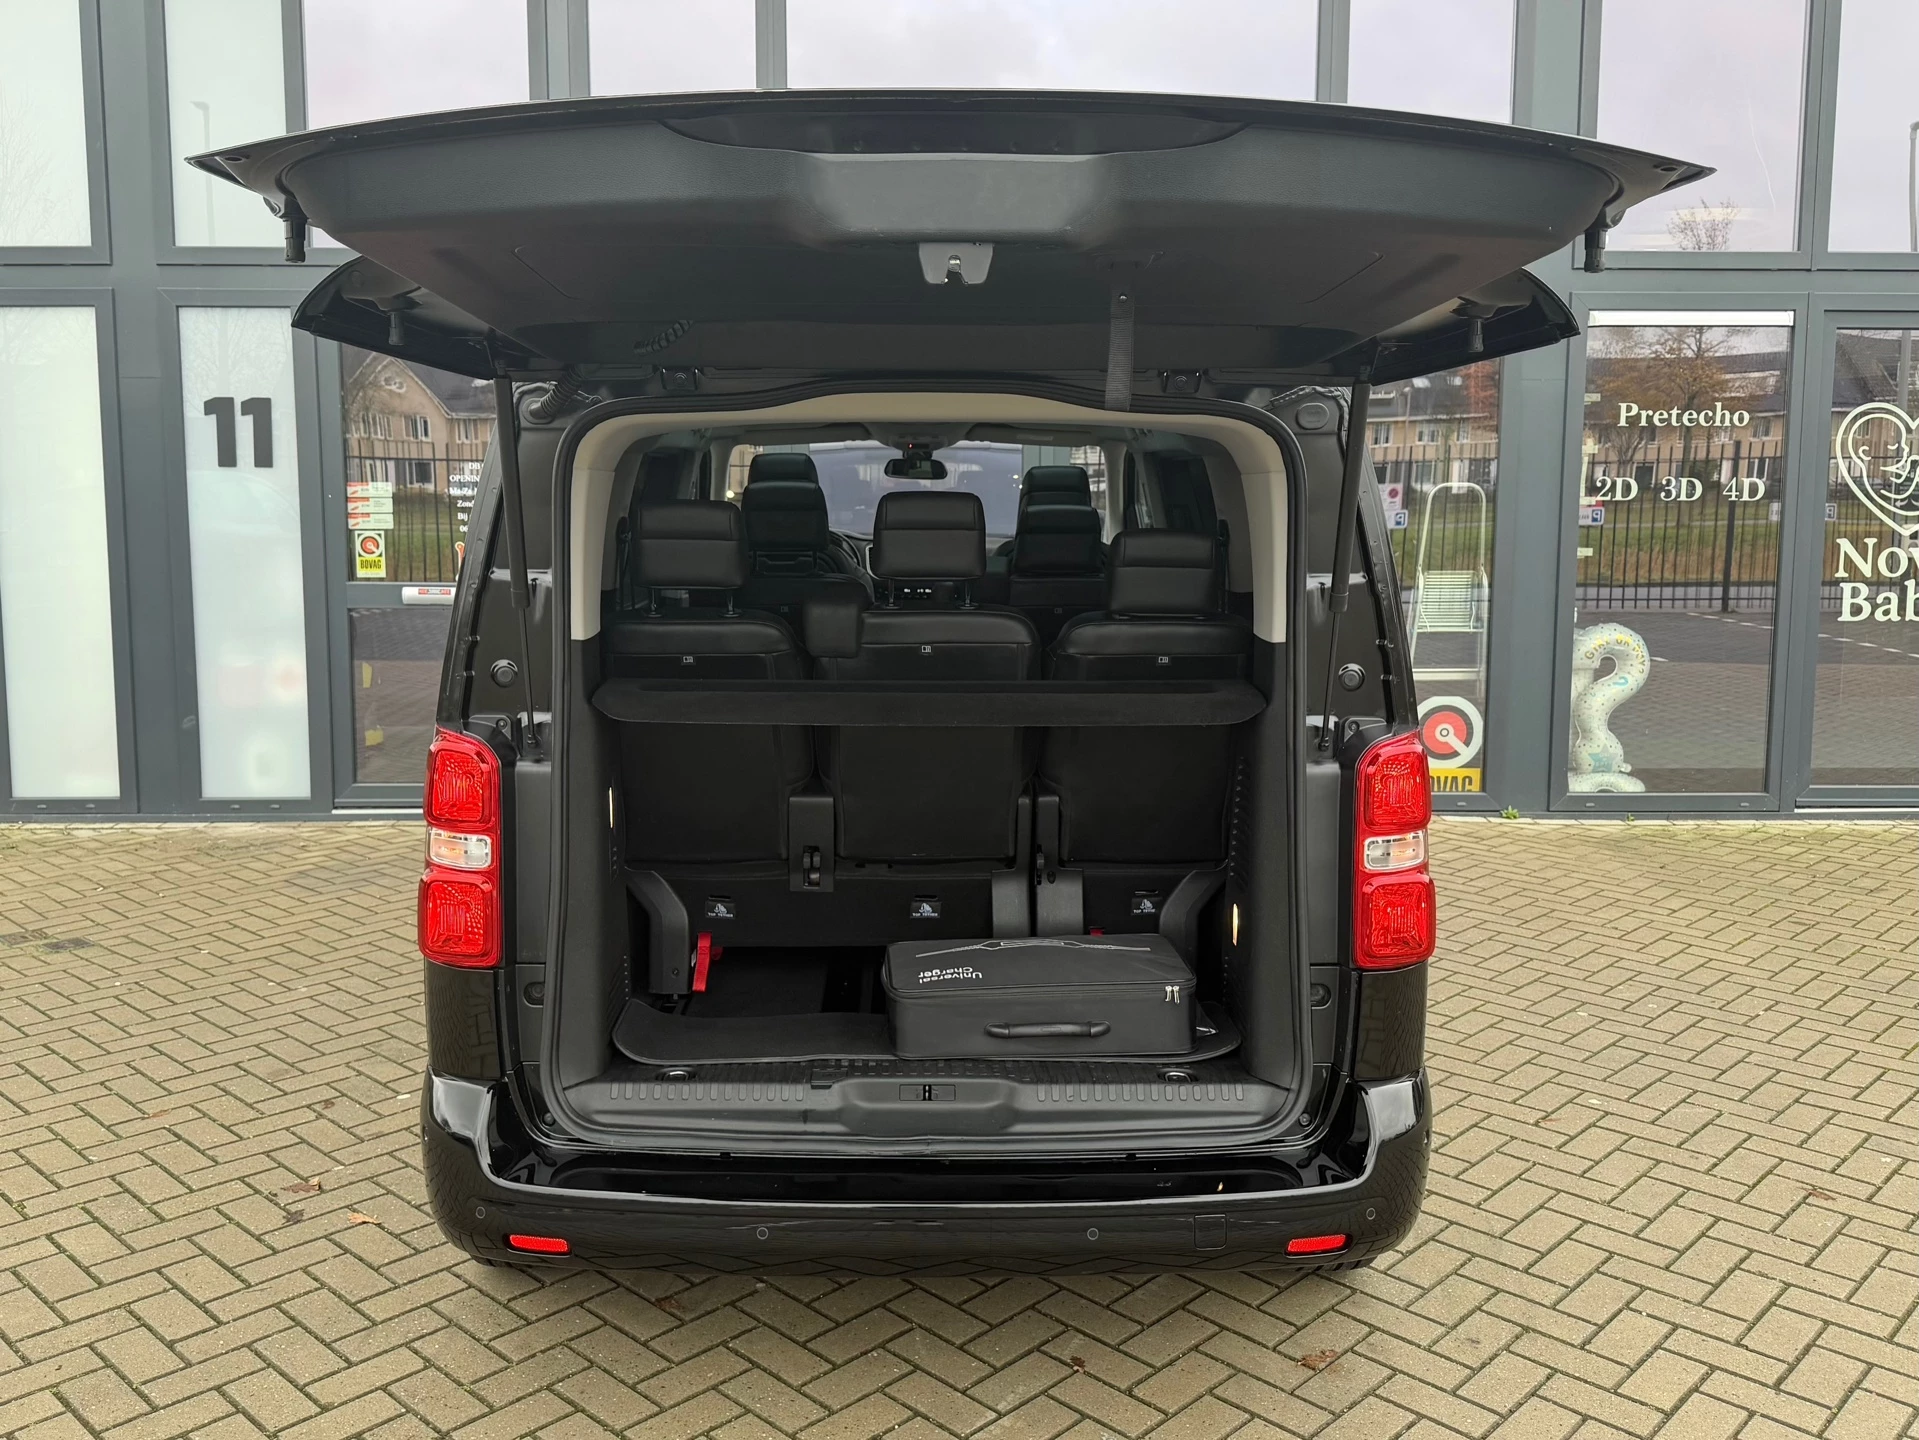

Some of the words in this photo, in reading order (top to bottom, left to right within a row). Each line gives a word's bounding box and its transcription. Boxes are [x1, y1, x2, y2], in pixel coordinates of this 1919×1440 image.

[1617, 402, 1750, 427] Pretecho
[203, 397, 273, 468] 11
[1596, 477, 1639, 501] 2D
[1660, 476, 1703, 501] 3D
[1723, 477, 1766, 501] 4D
[360, 559, 382, 569] BOVAG
[918, 966, 974, 978] Charger
[919, 972, 983, 984] Universal
